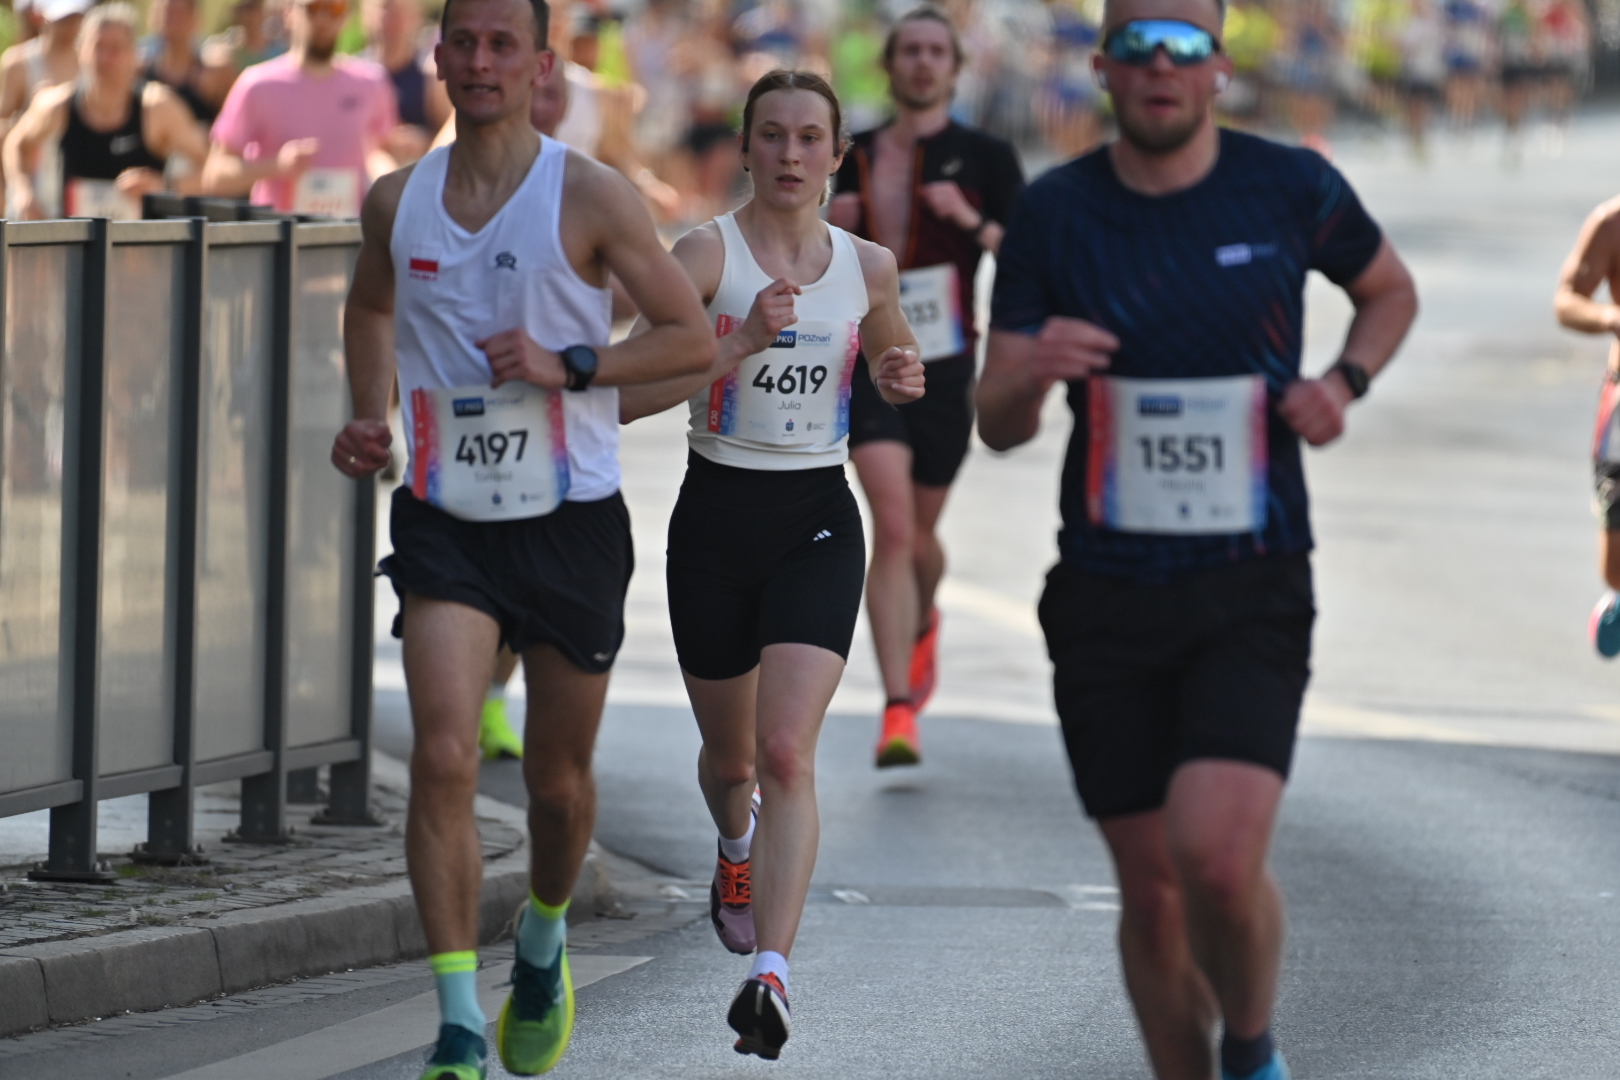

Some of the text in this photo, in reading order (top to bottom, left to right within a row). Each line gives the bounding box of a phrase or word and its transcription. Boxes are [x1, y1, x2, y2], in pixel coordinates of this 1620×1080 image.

[752, 364, 828, 395] 4619
[778, 400, 802, 411] Julia
[455, 429, 529, 467] 4197
[1138, 434, 1225, 473] 1551
